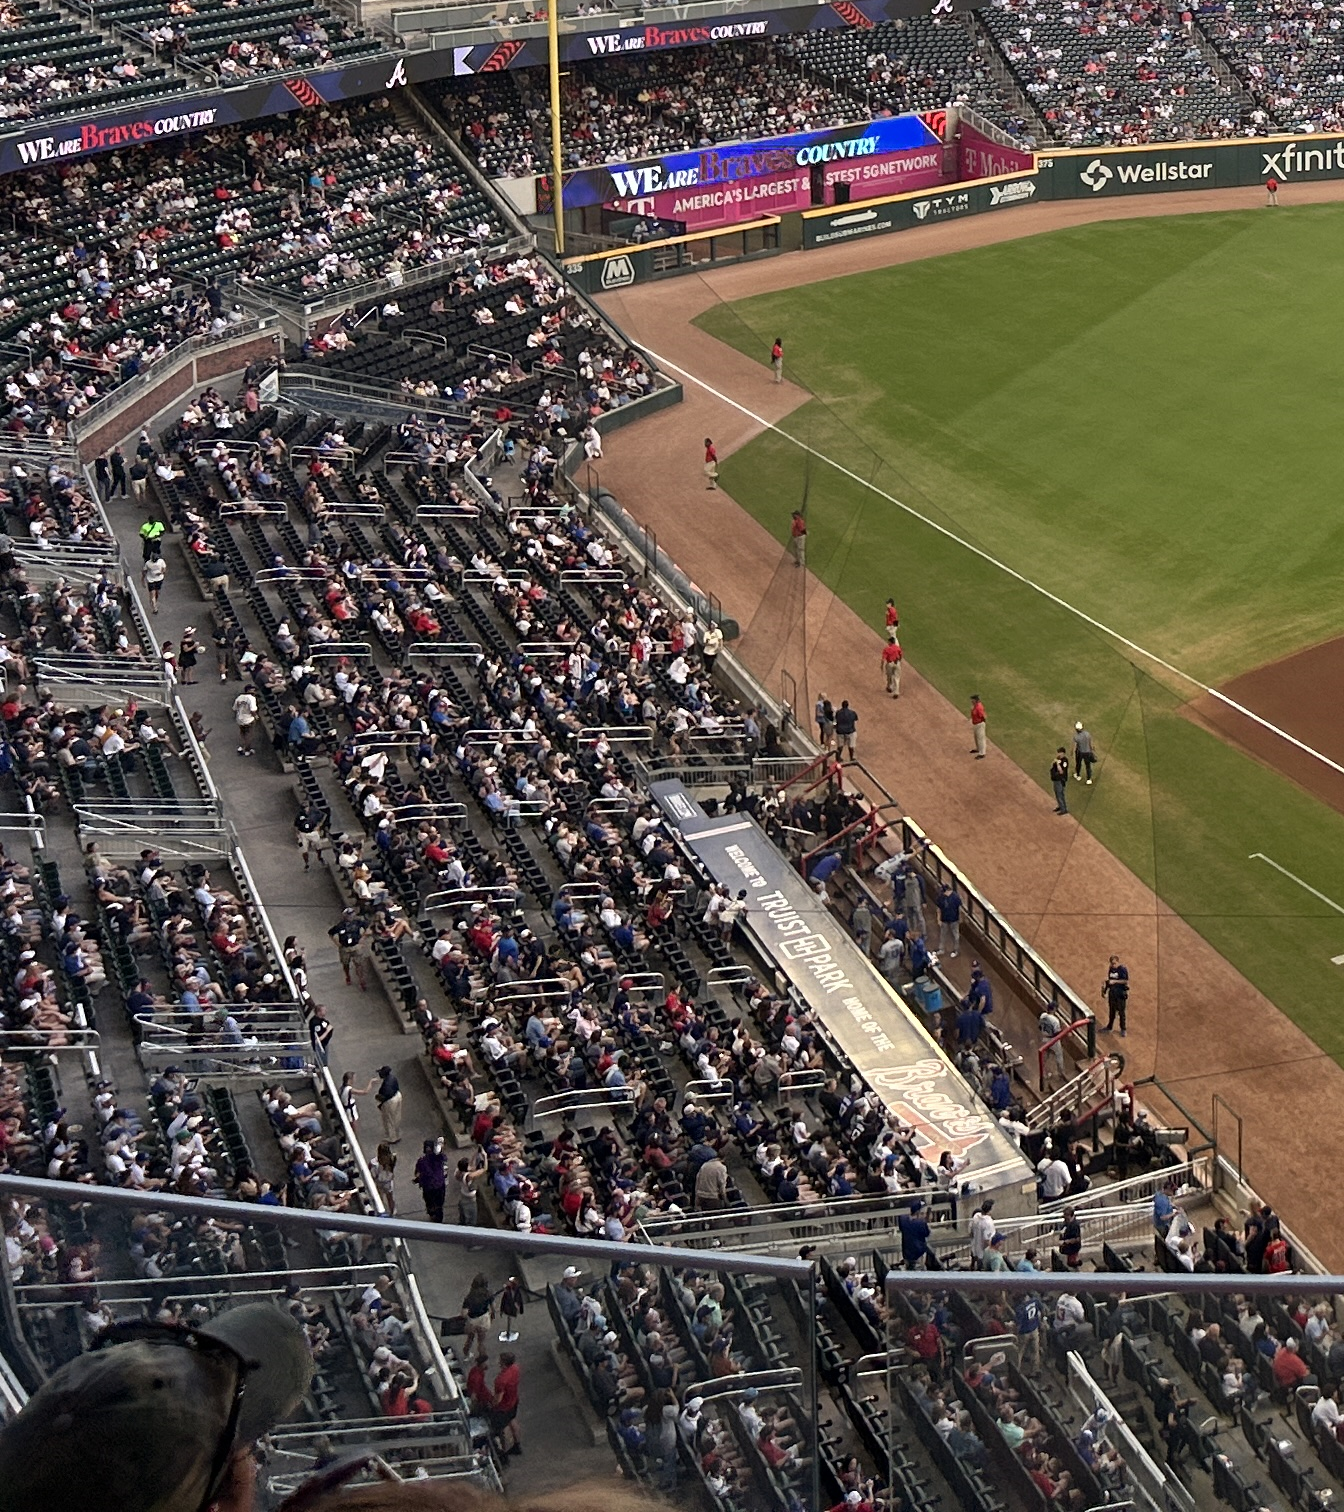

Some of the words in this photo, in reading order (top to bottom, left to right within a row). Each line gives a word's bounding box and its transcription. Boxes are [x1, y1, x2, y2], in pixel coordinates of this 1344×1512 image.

[587, 33, 622, 54] WE
[620, 36, 645, 51] ARE
[645, 25, 710, 48] Braves
[710, 19, 768, 41] COUNTRY
[17, 136, 54, 164] WE
[53, 138, 81, 157] ARE
[81, 121, 154, 152] Braves
[153, 108, 216, 137] COUNTRY
[610, 168, 663, 198] WE
[662, 168, 700, 191] ARE
[700, 148, 796, 183] Braves
[796, 135, 881, 166] COUNTRY
[1038, 159, 1054, 168] 375
[1117, 161, 1212, 184] Wellstar
[673, 187, 743, 214] AMERICA'S
[744, 178, 799, 200] LARGEST
[801, 176, 811, 190] &
[879, 154, 938, 177] NETWORK
[567, 262, 584, 275] 335
[725, 844, 757, 879] WELCOME
[751, 873, 768, 889] TO
[756, 890, 812, 941] TRUIST
[803, 953, 854, 995] PARK
[842, 997, 869, 1027] HOME
[861, 1021, 879, 1037] OF
[870, 1028, 896, 1053] THE
